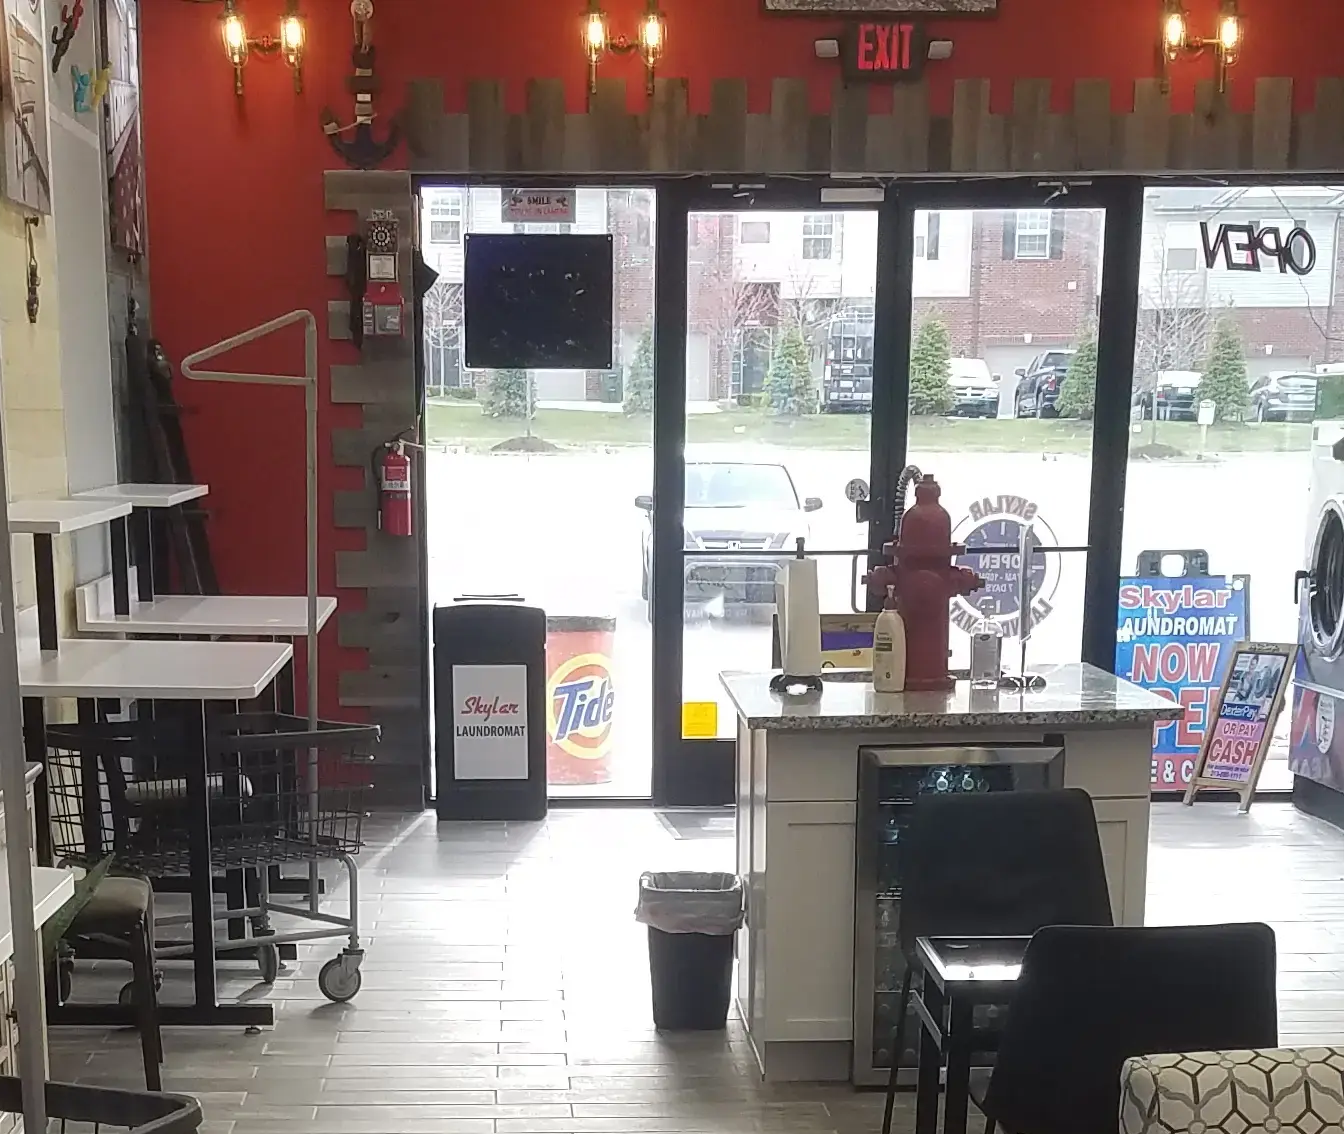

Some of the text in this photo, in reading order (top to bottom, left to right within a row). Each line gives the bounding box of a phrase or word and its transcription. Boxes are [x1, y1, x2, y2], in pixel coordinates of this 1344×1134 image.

[857, 23, 914, 71] EXIT
[1119, 585, 1232, 614] Skylar
[1121, 616, 1239, 637] AUNDROMAT
[1130, 642, 1220, 683] NOW
[460, 696, 519, 722] Skylar
[553, 675, 615, 741] Tide
[1219, 703, 1258, 723] DexterPay
[456, 725, 526, 737] LAUNDROMAT
[1223, 722, 1256, 738] OR PAY
[1208, 738, 1260, 766] CASH
